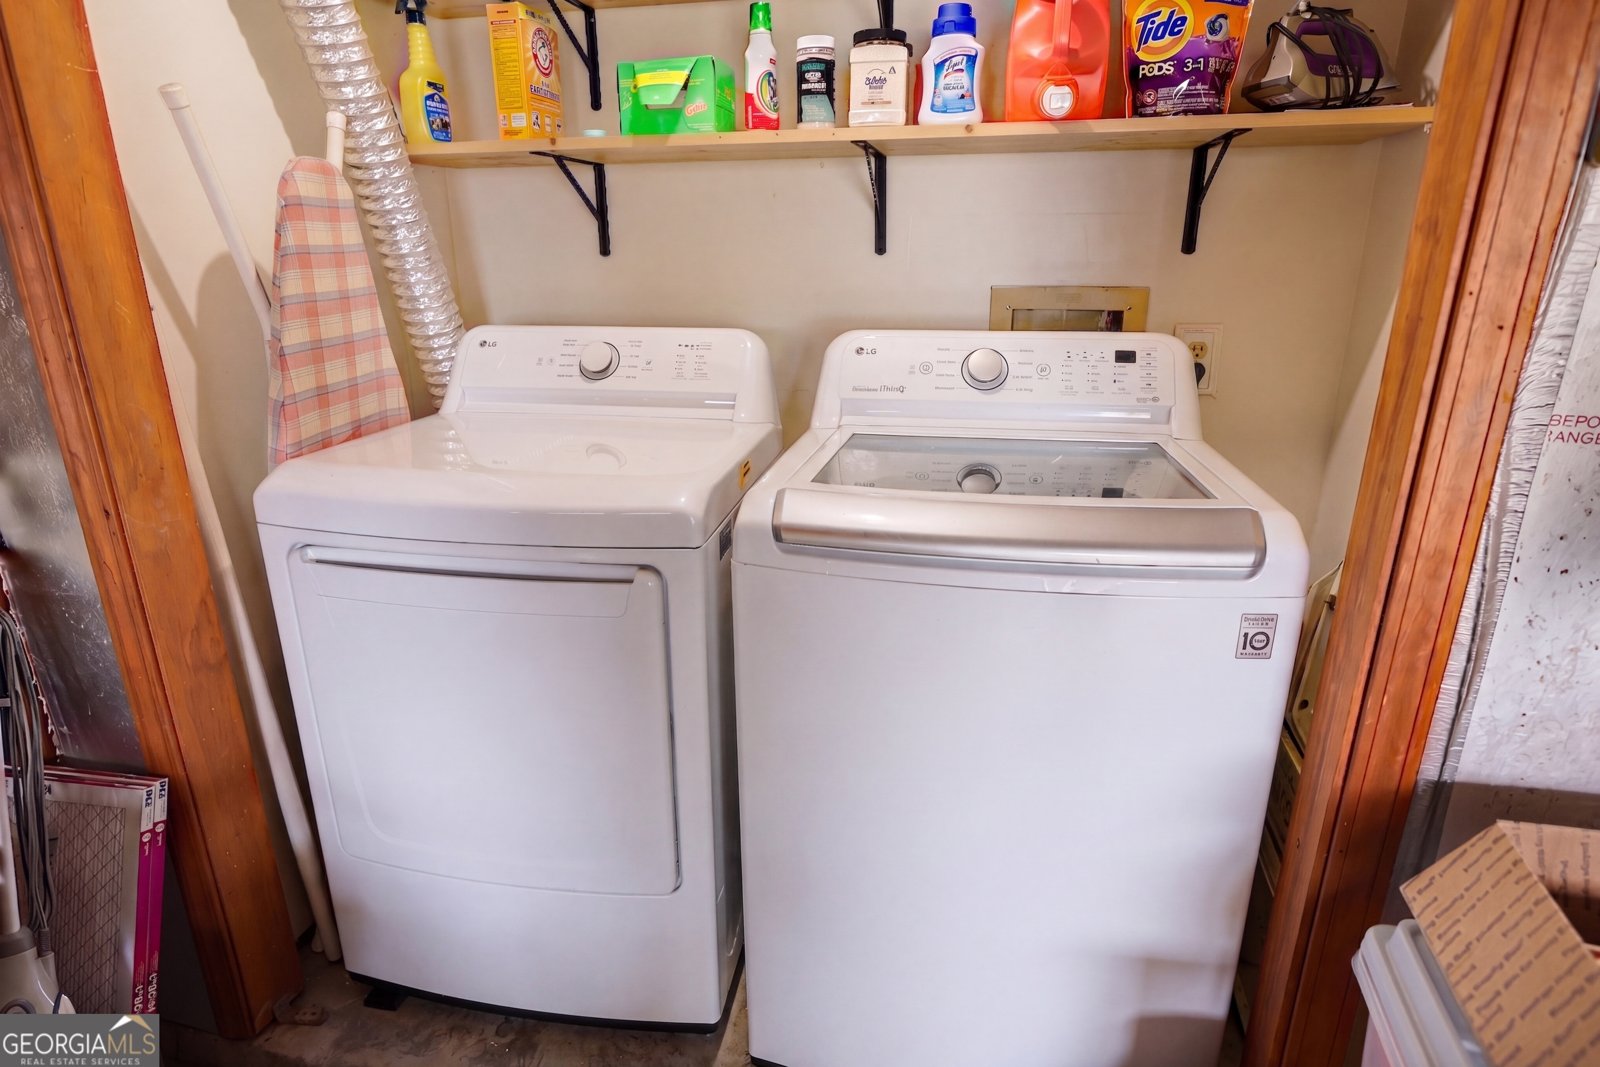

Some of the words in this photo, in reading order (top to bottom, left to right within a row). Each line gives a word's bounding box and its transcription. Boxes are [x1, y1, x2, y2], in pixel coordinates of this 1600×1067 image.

[1135, 8, 1189, 53] Tide
[1139, 61, 1175, 79] PODS
[1242, 631, 1270, 651] 10
